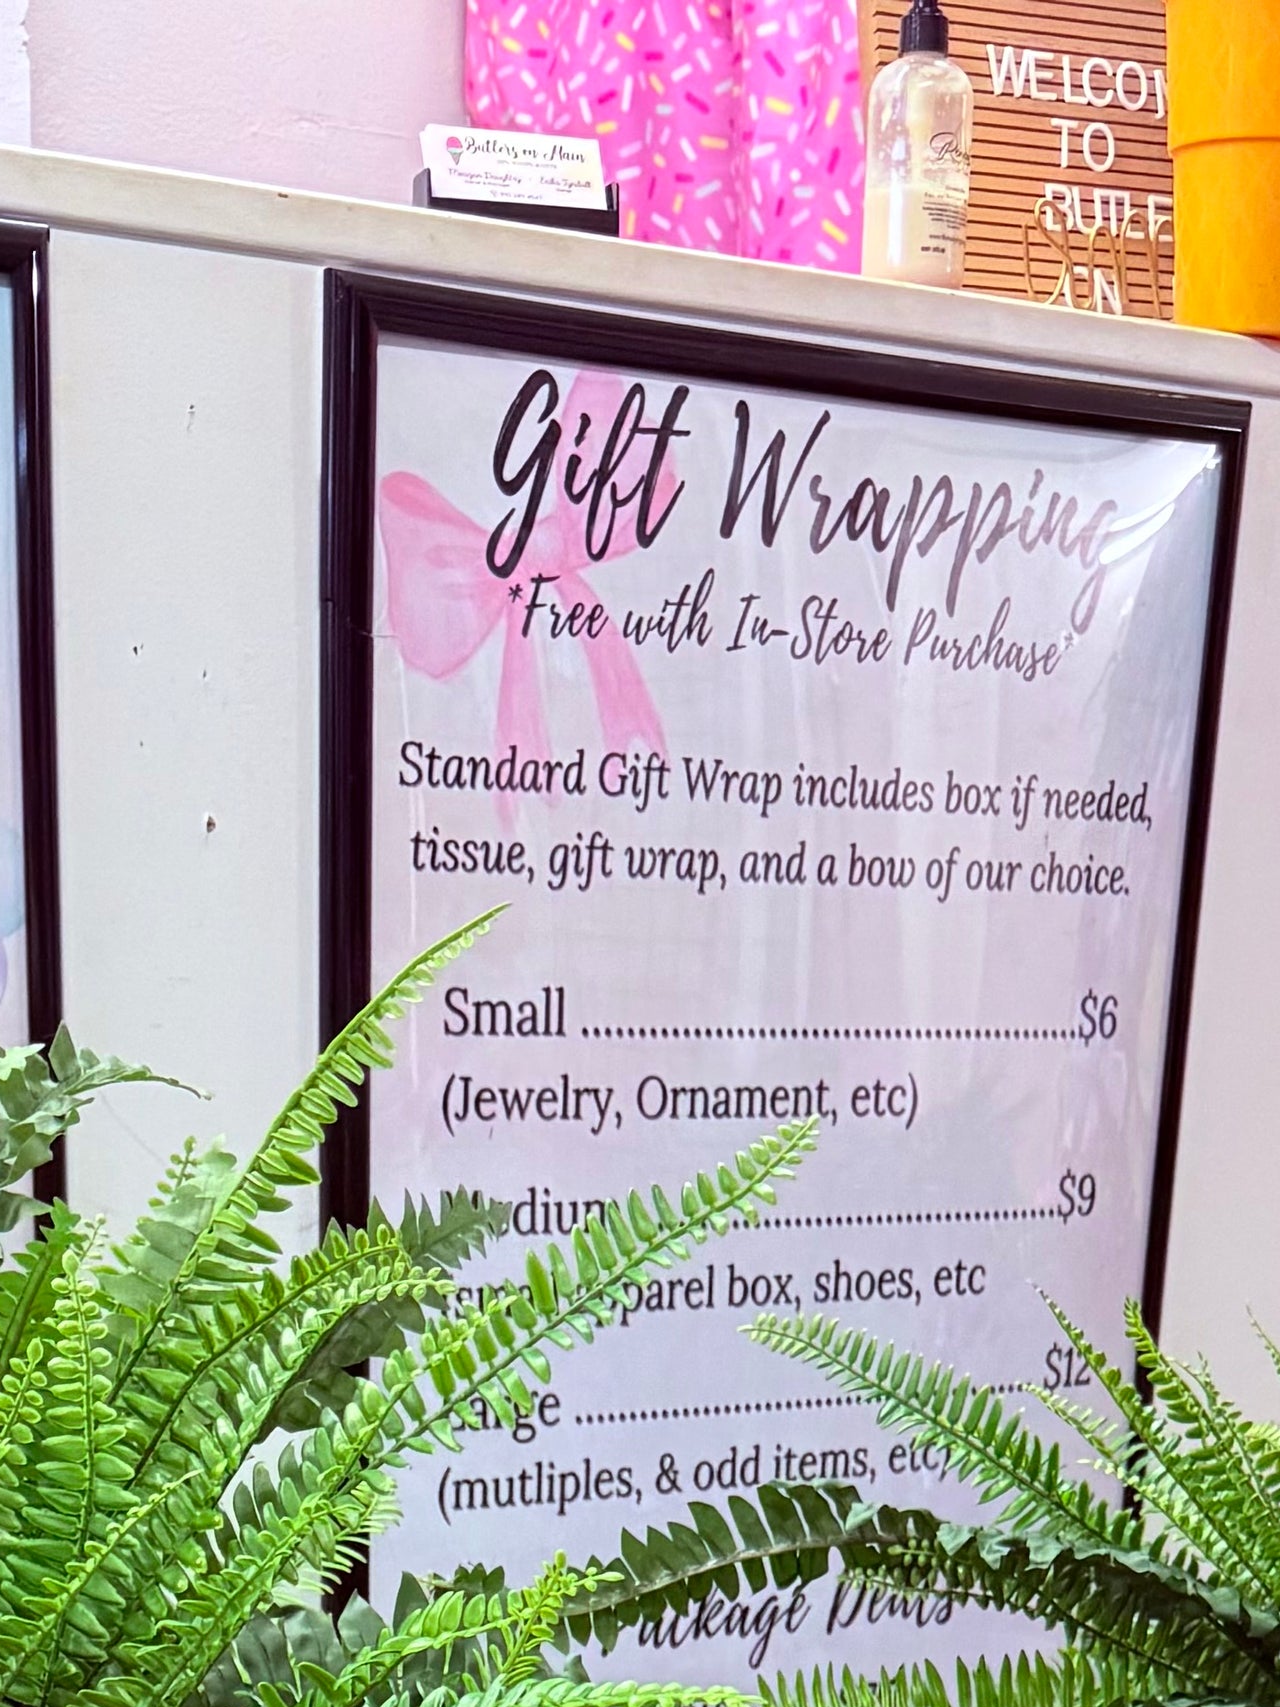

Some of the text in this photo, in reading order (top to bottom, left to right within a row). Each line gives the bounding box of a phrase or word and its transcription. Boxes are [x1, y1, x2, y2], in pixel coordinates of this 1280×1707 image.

[1050, 118, 1116, 173] TO
[485, 369, 1118, 635] Gift Wrapping
[622, 567, 715, 654] with
[725, 593, 892, 666] In-Store
[399, 740, 1152, 832] Standard Gift Wrap includes box if needed,
[410, 826, 1130, 904] tissue, gift wrap, and a bow of our choice.
[444, 986, 566, 1037] Small
[442, 1073, 918, 1136] (Jewelry, Ornament, etc)
[727, 1263, 801, 1312] box,
[813, 1259, 921, 1306] shoes,
[933, 1260, 986, 1297] etc
[438, 1457, 642, 1524] (mutliples,
[655, 1453, 682, 1495] &
[693, 1444, 760, 1491] odd
[774, 1443, 876, 1484] items,
[601, 1588, 811, 1670] ackage
